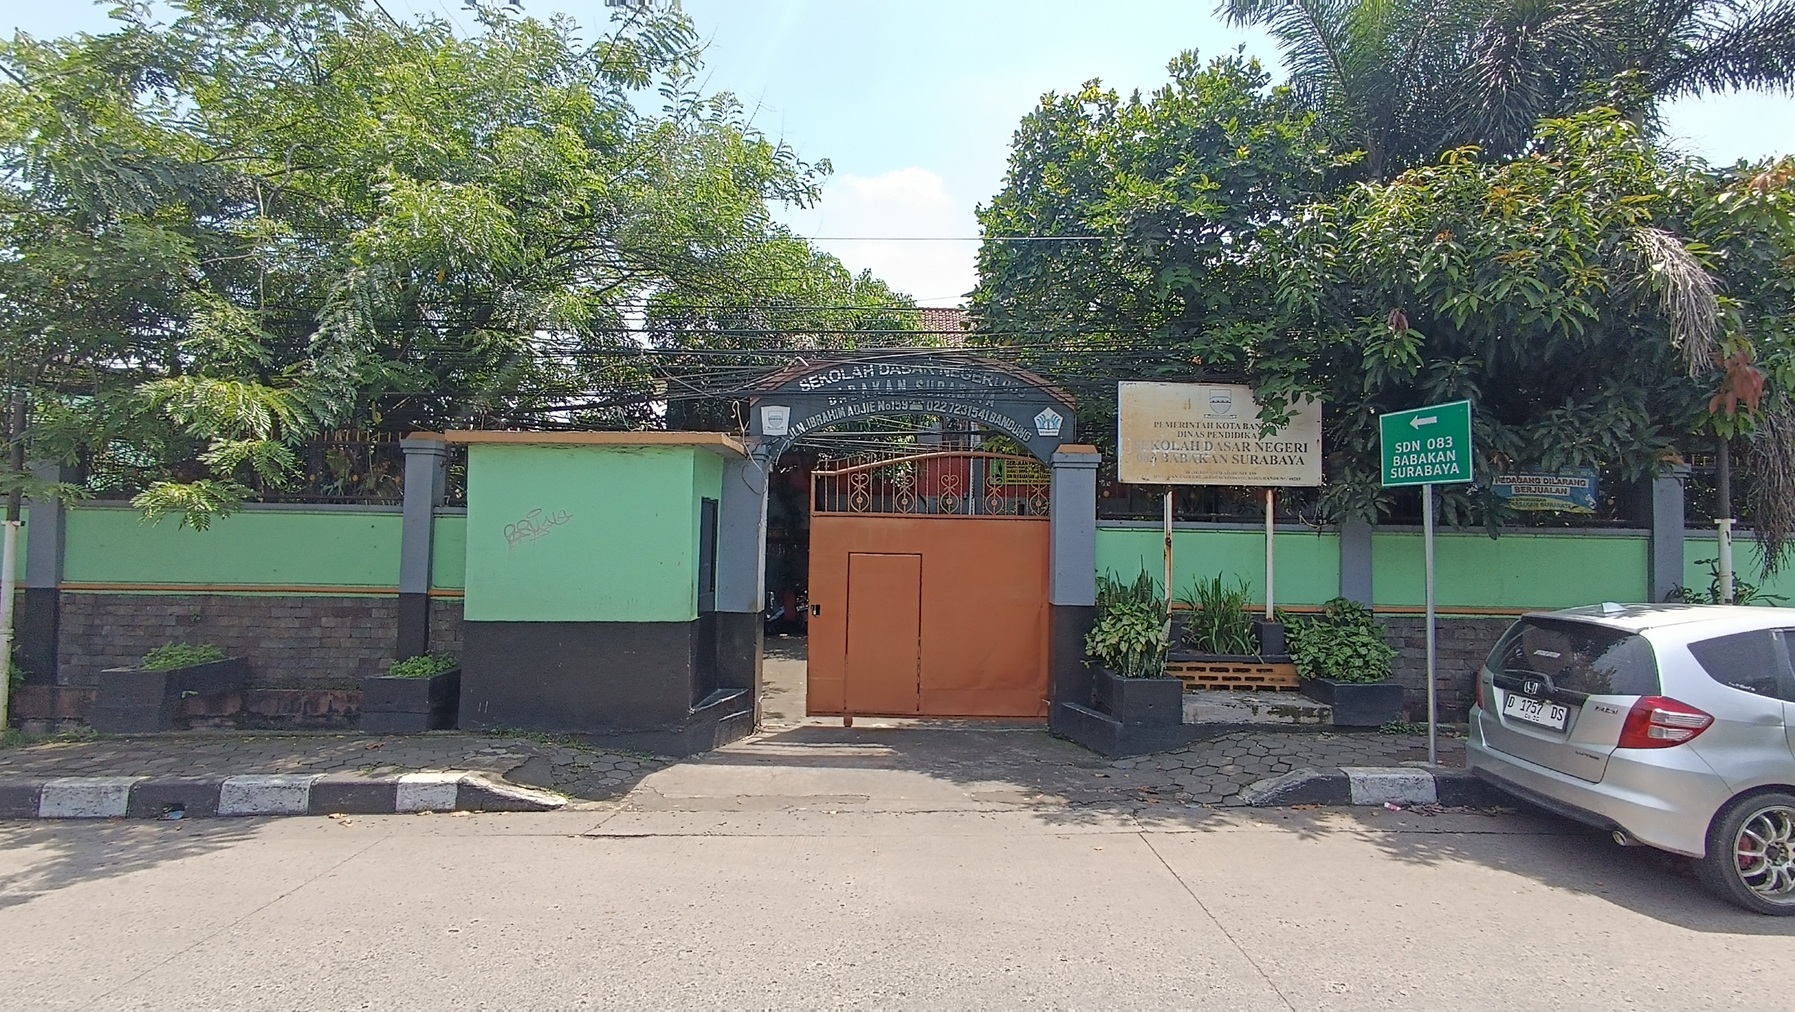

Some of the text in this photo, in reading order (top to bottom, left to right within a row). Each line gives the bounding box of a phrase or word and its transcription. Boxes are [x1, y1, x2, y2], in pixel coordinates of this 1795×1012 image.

[799, 364, 875, 392] SEKOLAH
[847, 401, 876, 417] ADJIE
[926, 400, 947, 413] 022
[949, 402, 989, 421] 7231541
[989, 413, 1032, 442] BANDUNG
[1154, 421, 1288, 431] PEMERINTAH KOTA BANNG
[1134, 440, 1308, 453] SEKOLAH DASAR NEGERI
[1395, 436, 1453, 453] SDN 083
[1161, 452, 1228, 464] BABAKAN
[1231, 454, 1305, 465] SURABAYA
[1393, 450, 1456, 466] BABAKAN
[1390, 462, 1460, 479] SURABAYA
[1543, 477, 1587, 486] DILARANG
[1514, 486, 1568, 495] BERJUALAN
[1508, 696, 1516, 708] D
[1519, 699, 1544, 715] 1757
[1550, 706, 1565, 721] DS
